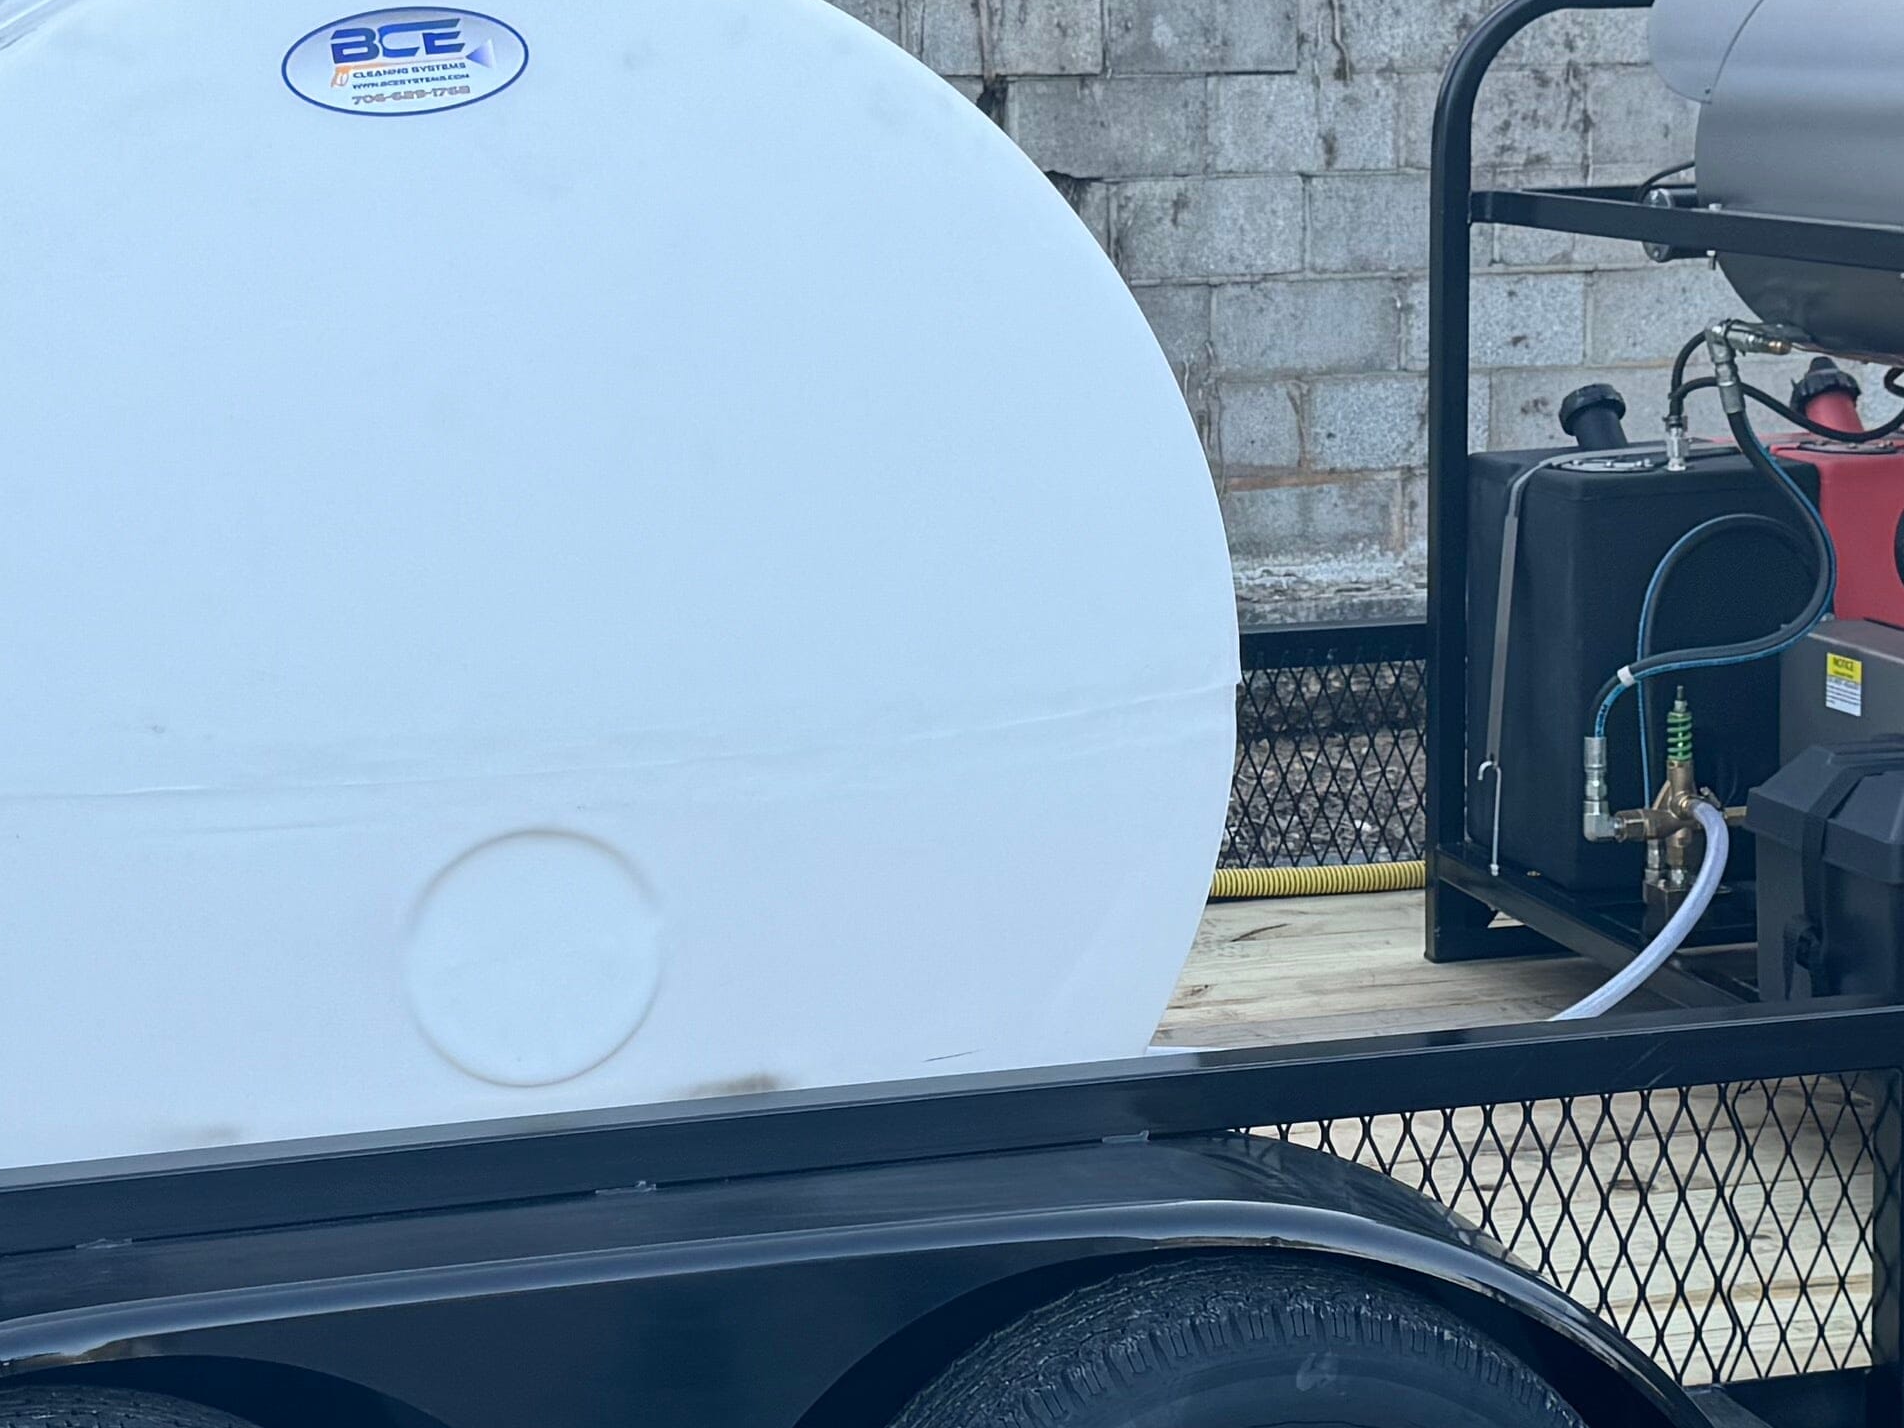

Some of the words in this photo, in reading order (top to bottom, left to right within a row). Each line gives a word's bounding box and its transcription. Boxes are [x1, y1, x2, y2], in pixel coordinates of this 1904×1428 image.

[330, 18, 466, 64] BCE
[352, 67, 409, 79] CLEANING
[411, 62, 467, 74] SYSTEMS
